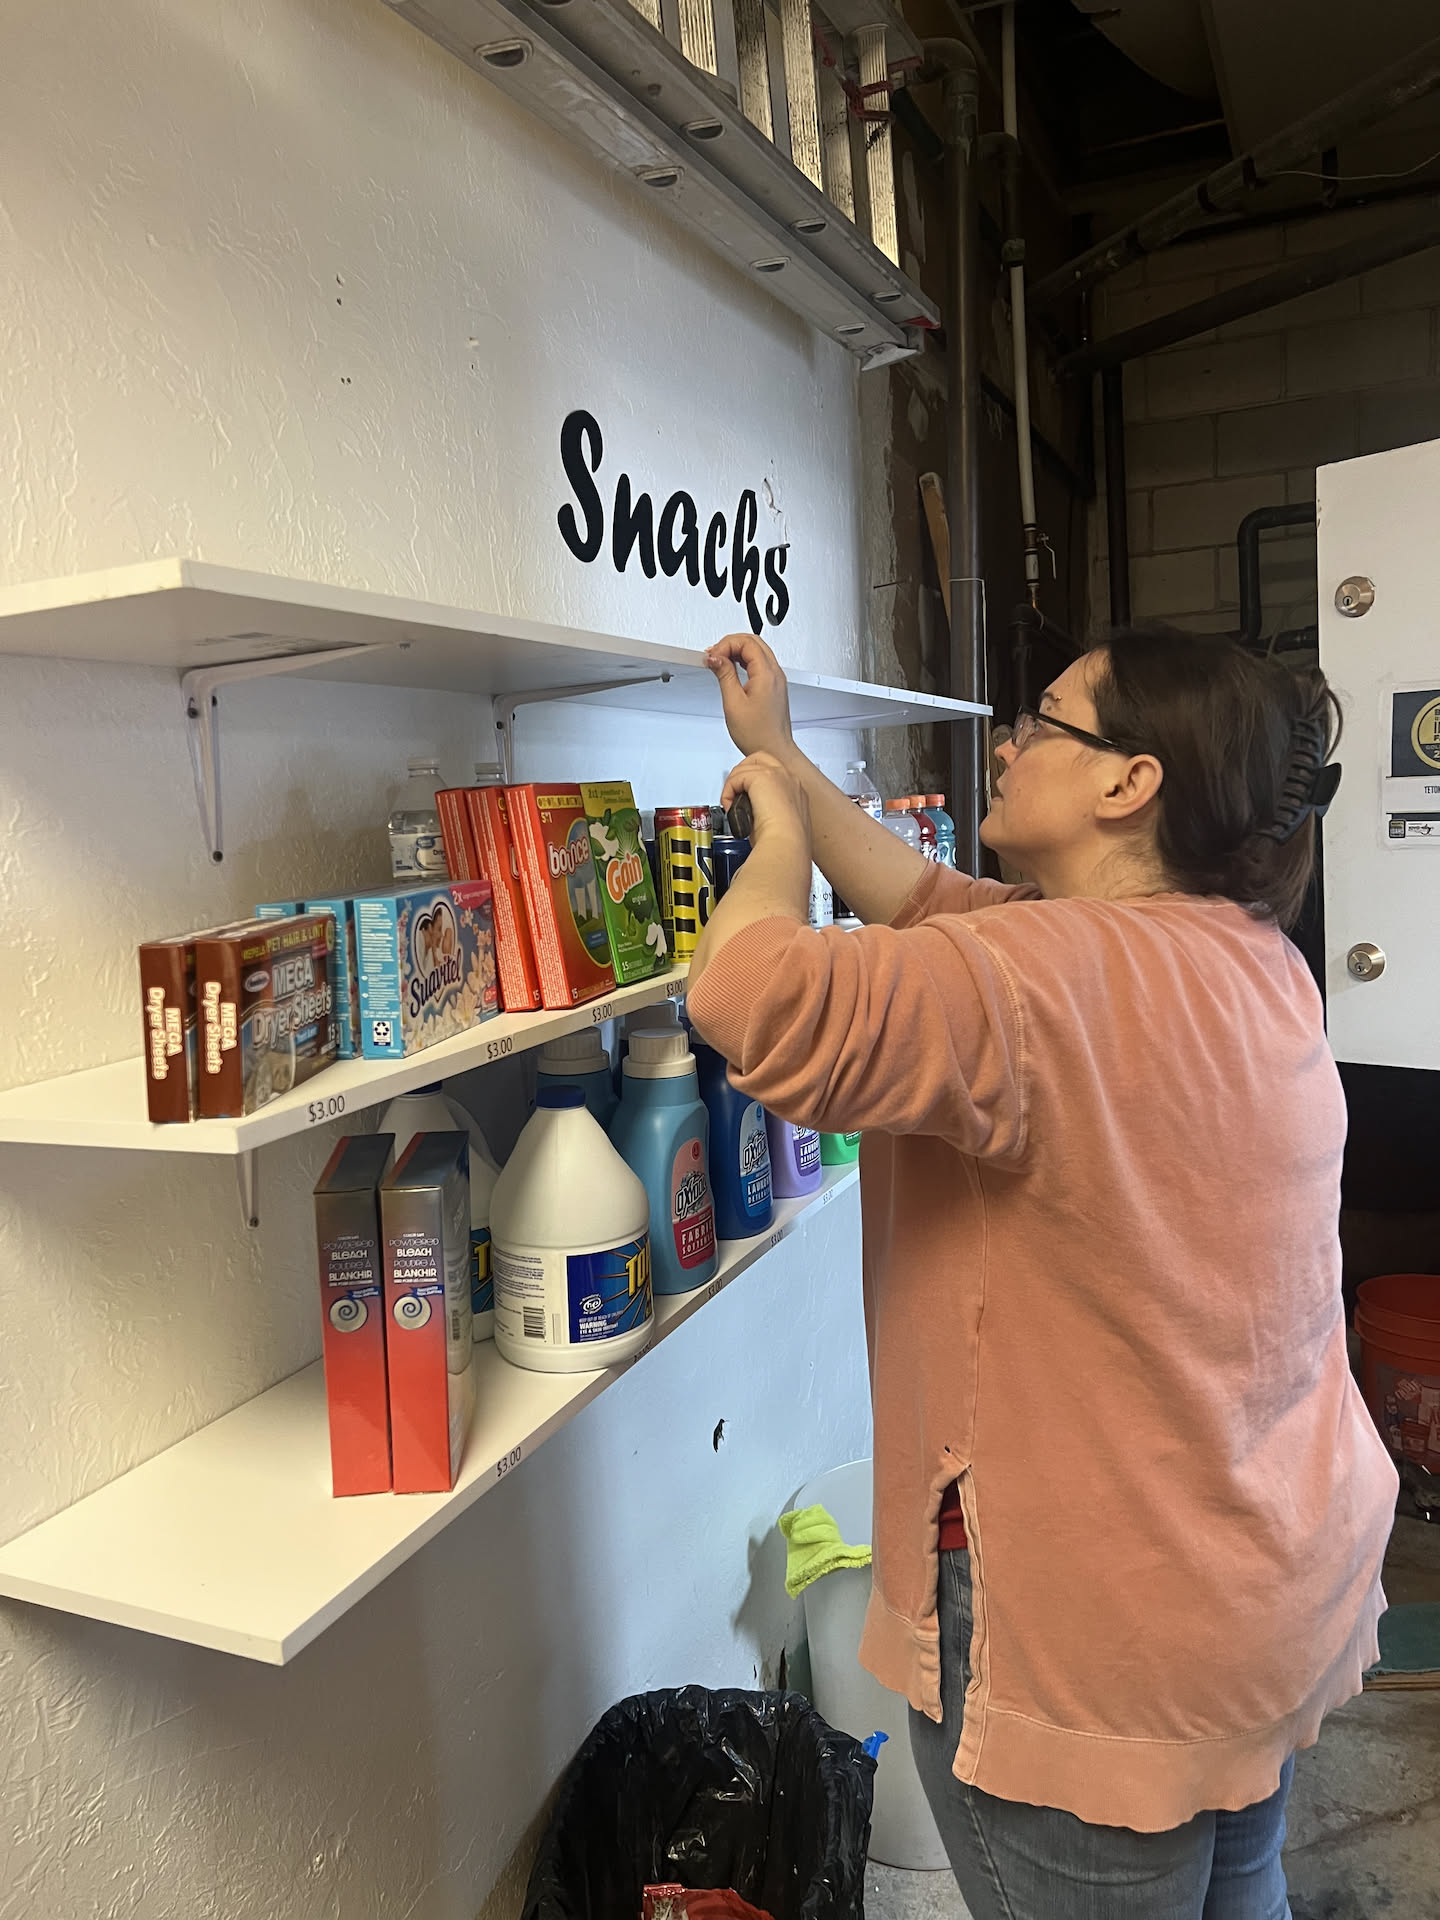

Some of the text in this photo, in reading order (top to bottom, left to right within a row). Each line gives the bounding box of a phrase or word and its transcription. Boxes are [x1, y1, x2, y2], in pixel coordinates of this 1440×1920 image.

[557, 409, 791, 636] Snacks
[548, 837, 589, 877] bounce
[606, 852, 644, 904] Gain
[273, 954, 314, 997] MEGA
[410, 947, 461, 1018] Suavitel
[667, 980, 683, 997] $3.00
[203, 982, 223, 1074] Dryer Sheets
[221, 1002, 237, 1051] MEGA
[254, 982, 333, 1048] Dryer Sheets
[592, 1003, 613, 1023] $3.00
[146, 987, 169, 1079] Dryer Sheets
[165, 1008, 183, 1056] MEGA
[487, 1037, 513, 1059] $3.00
[309, 1095, 345, 1122] $3.00
[332, 1249, 368, 1261] BLEACH
[396, 1247, 432, 1257] BLEACH
[329, 1269, 373, 1281] BLANCHIR
[393, 1268, 437, 1279] BLANCHIR
[579, 1320, 607, 1330] WARNING
[496, 1446, 521, 1477] $3.00
